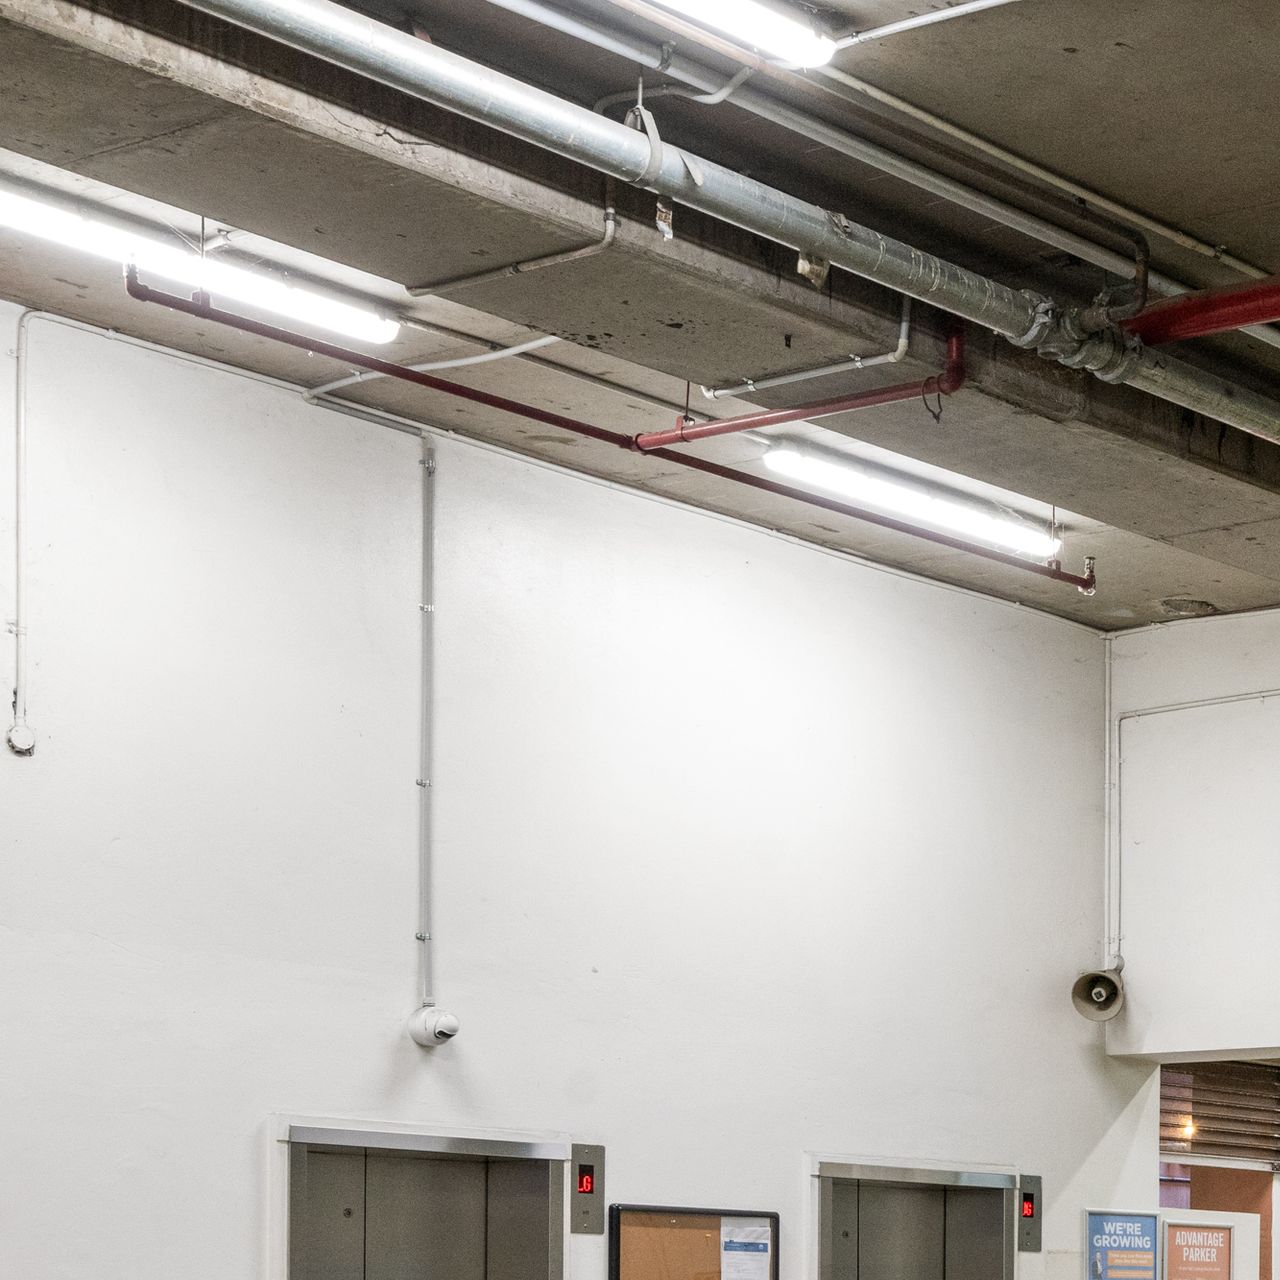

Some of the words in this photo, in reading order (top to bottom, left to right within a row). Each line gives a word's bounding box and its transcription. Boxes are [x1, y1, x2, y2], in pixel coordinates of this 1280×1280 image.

[1103, 1222, 1141, 1234] WE'RE
[1093, 1235, 1150, 1248] GROWING
[1175, 1232, 1224, 1247] ADVANTAGE
[1183, 1248, 1217, 1262] PARKER
